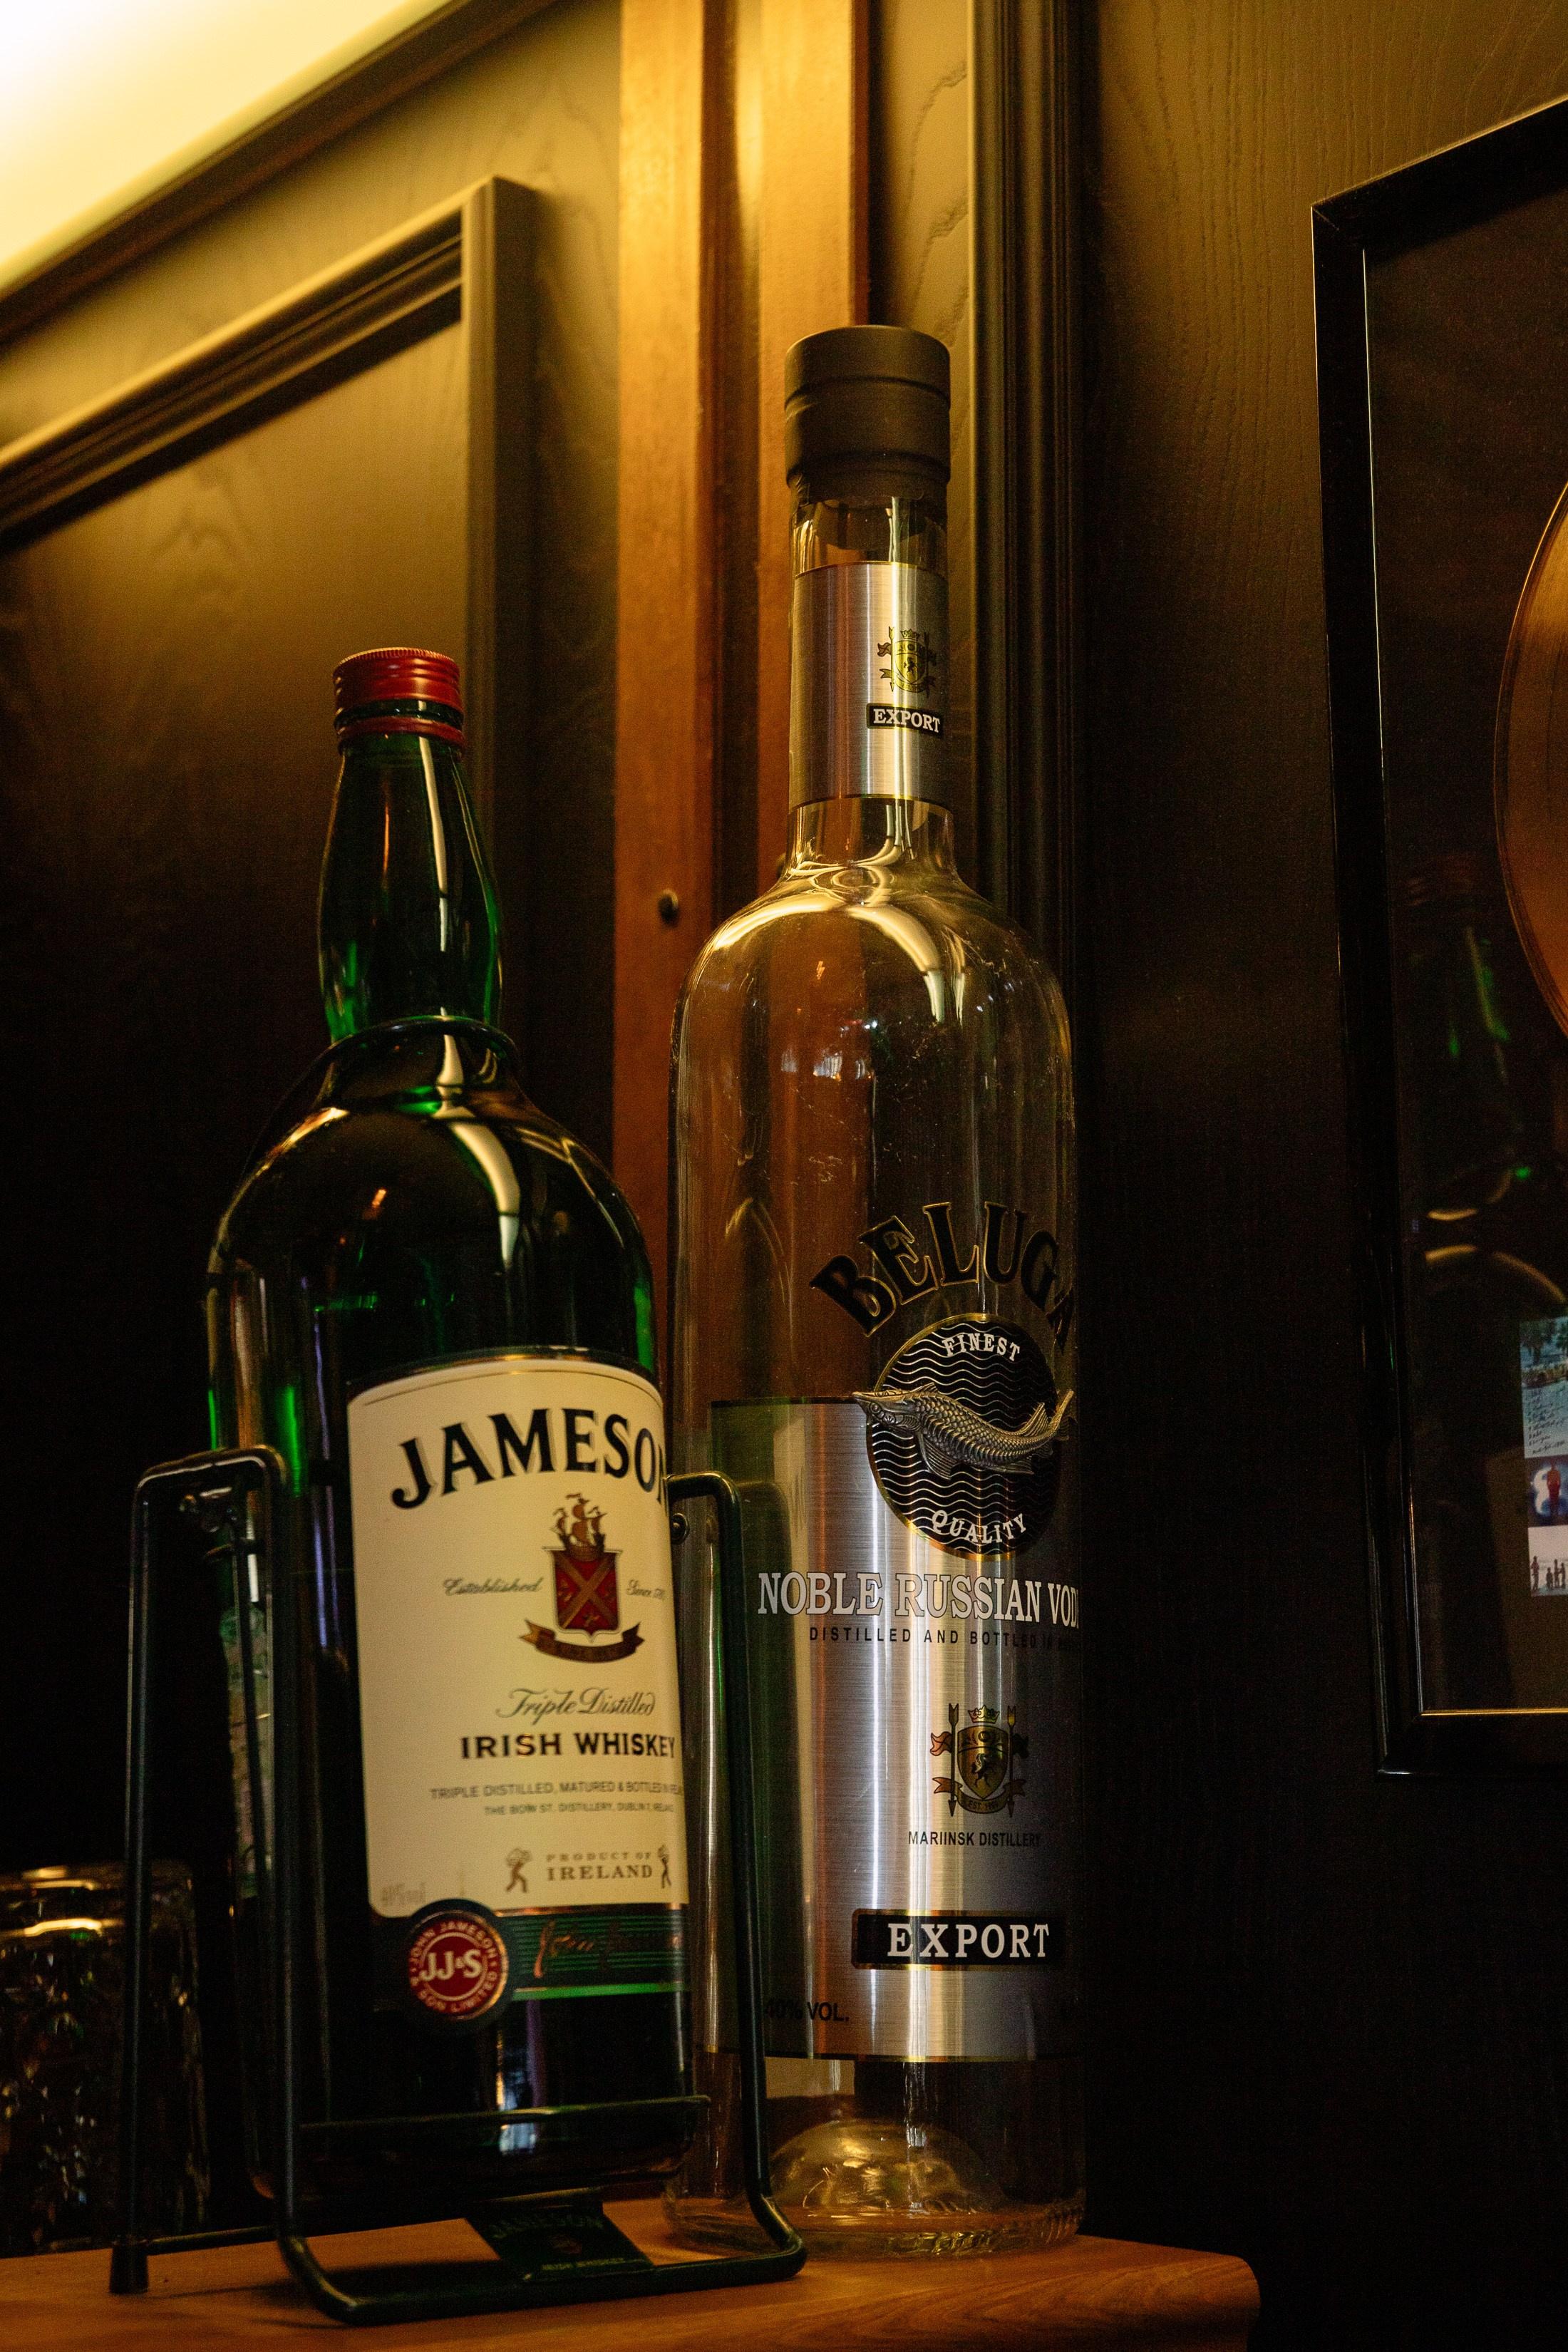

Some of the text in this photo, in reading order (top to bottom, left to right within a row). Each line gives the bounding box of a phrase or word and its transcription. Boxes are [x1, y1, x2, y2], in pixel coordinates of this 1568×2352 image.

[873, 708, 941, 733] EXPORT
[941, 1332, 1021, 1363] FINEST
[931, 1510, 1028, 1545] QUALITY
[757, 1571, 884, 1616] NOBLE
[894, 1572, 1043, 1624] RUSSIAN
[809, 1626, 912, 1643] DISTILLED
[924, 1628, 959, 1644] AND
[969, 1631, 1037, 1648] BOTTLED
[495, 1687, 656, 1726] Triple Distilled
[460, 1733, 676, 1760] IRISH WHISKEY
[430, 1785, 478, 1800] TRIPLE
[559, 1780, 616, 1793] MATURED
[908, 1831, 1042, 1848] MARIINSK DISTILLERY
[546, 1851, 651, 1862] PRODUCT OF
[547, 1864, 653, 1881] IRELAND
[439, 1920, 499, 1959] JAMESON
[887, 1922, 1049, 1958] EXPORT
[418, 1989, 447, 2011] SON
[764, 1998, 850, 2021] 40% VOL.
